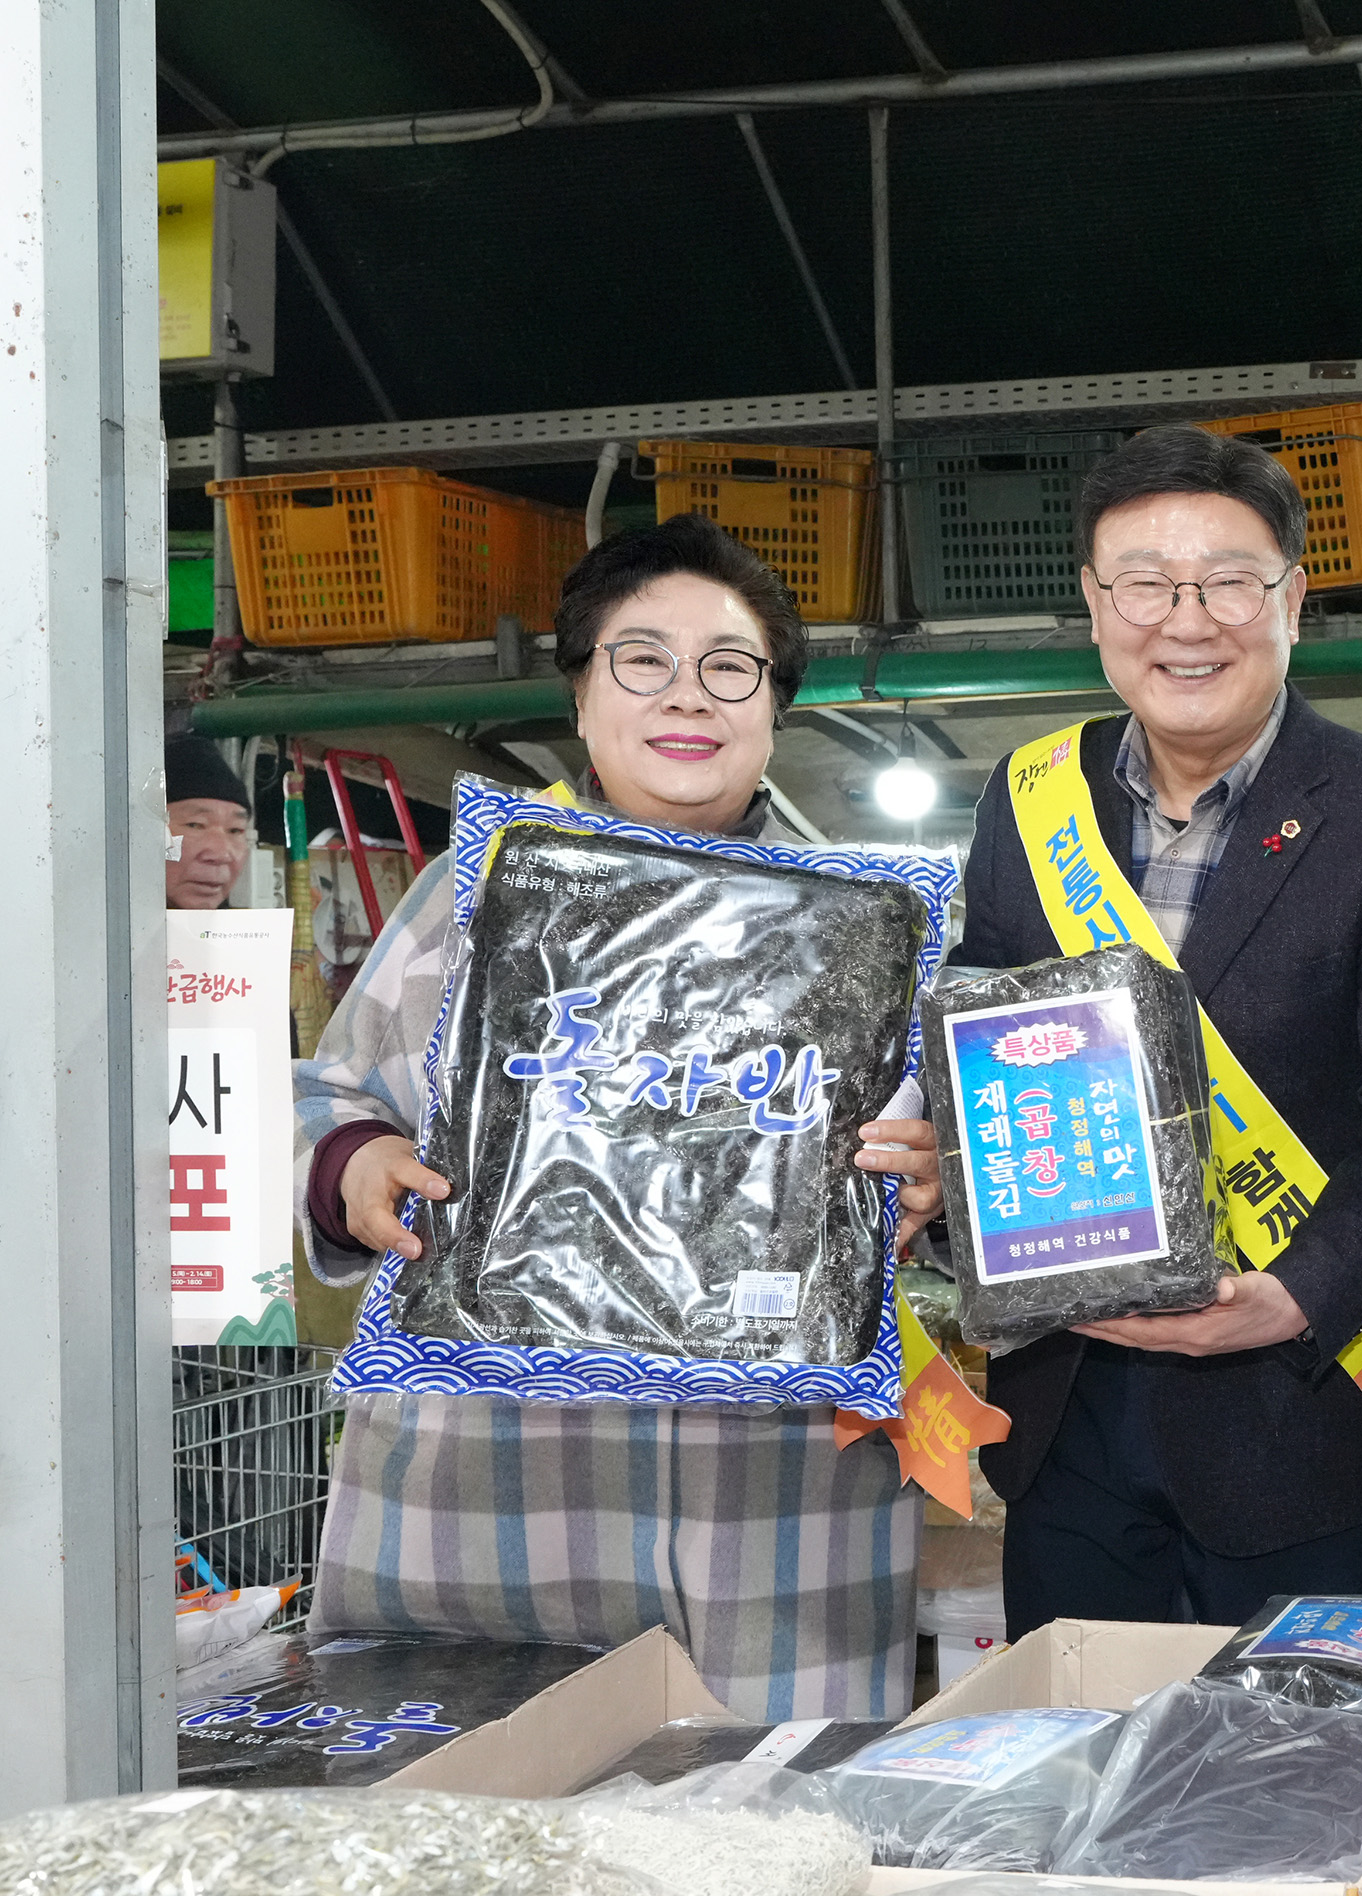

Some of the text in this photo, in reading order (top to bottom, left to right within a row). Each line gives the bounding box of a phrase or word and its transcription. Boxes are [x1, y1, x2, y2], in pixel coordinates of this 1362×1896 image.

[501, 872, 607, 899] 식품유형 해조류
[503, 987, 841, 1137] 돌자반
[1003, 1029, 1077, 1060] 특상품
[973, 1079, 1023, 1218] 재래돌김
[1067, 1097, 1096, 1178] 청정해역
[1226, 1147, 1314, 1246] 함께
[1008, 1227, 1132, 1258] 청정해역 건강식품
[907, 1384, 971, 1468] 情
